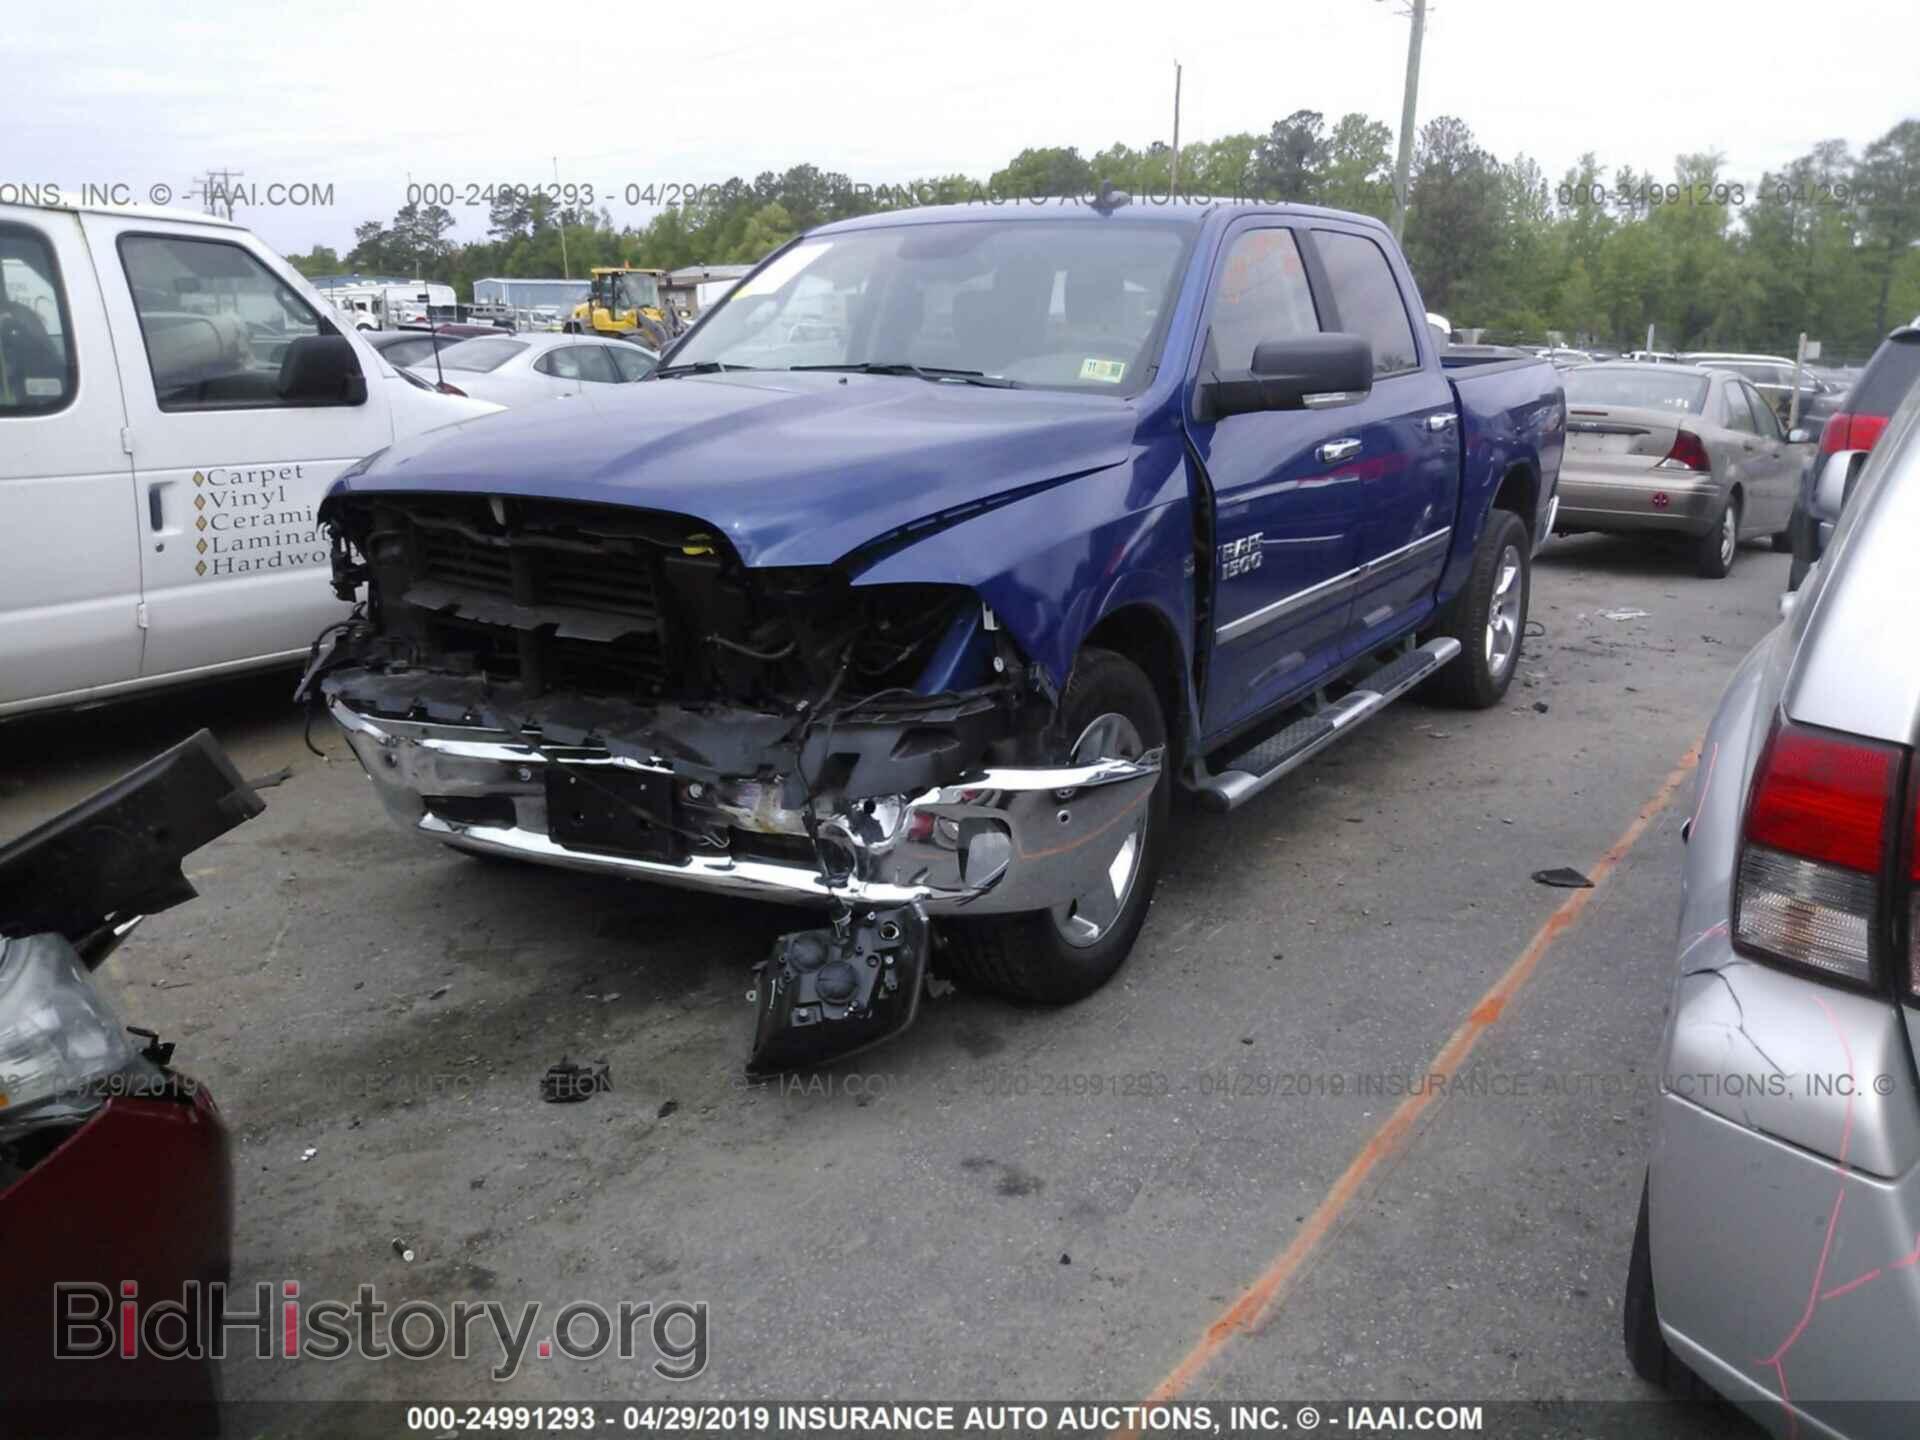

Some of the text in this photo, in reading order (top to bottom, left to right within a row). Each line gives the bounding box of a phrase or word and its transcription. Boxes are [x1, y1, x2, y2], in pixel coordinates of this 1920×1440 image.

[207, 465, 304, 487] Carpet
[209, 486, 287, 510] Vinyl
[210, 506, 313, 531] Cerami
[213, 550, 327, 575] Hardwo
[1221, 551, 1264, 580] 1500
